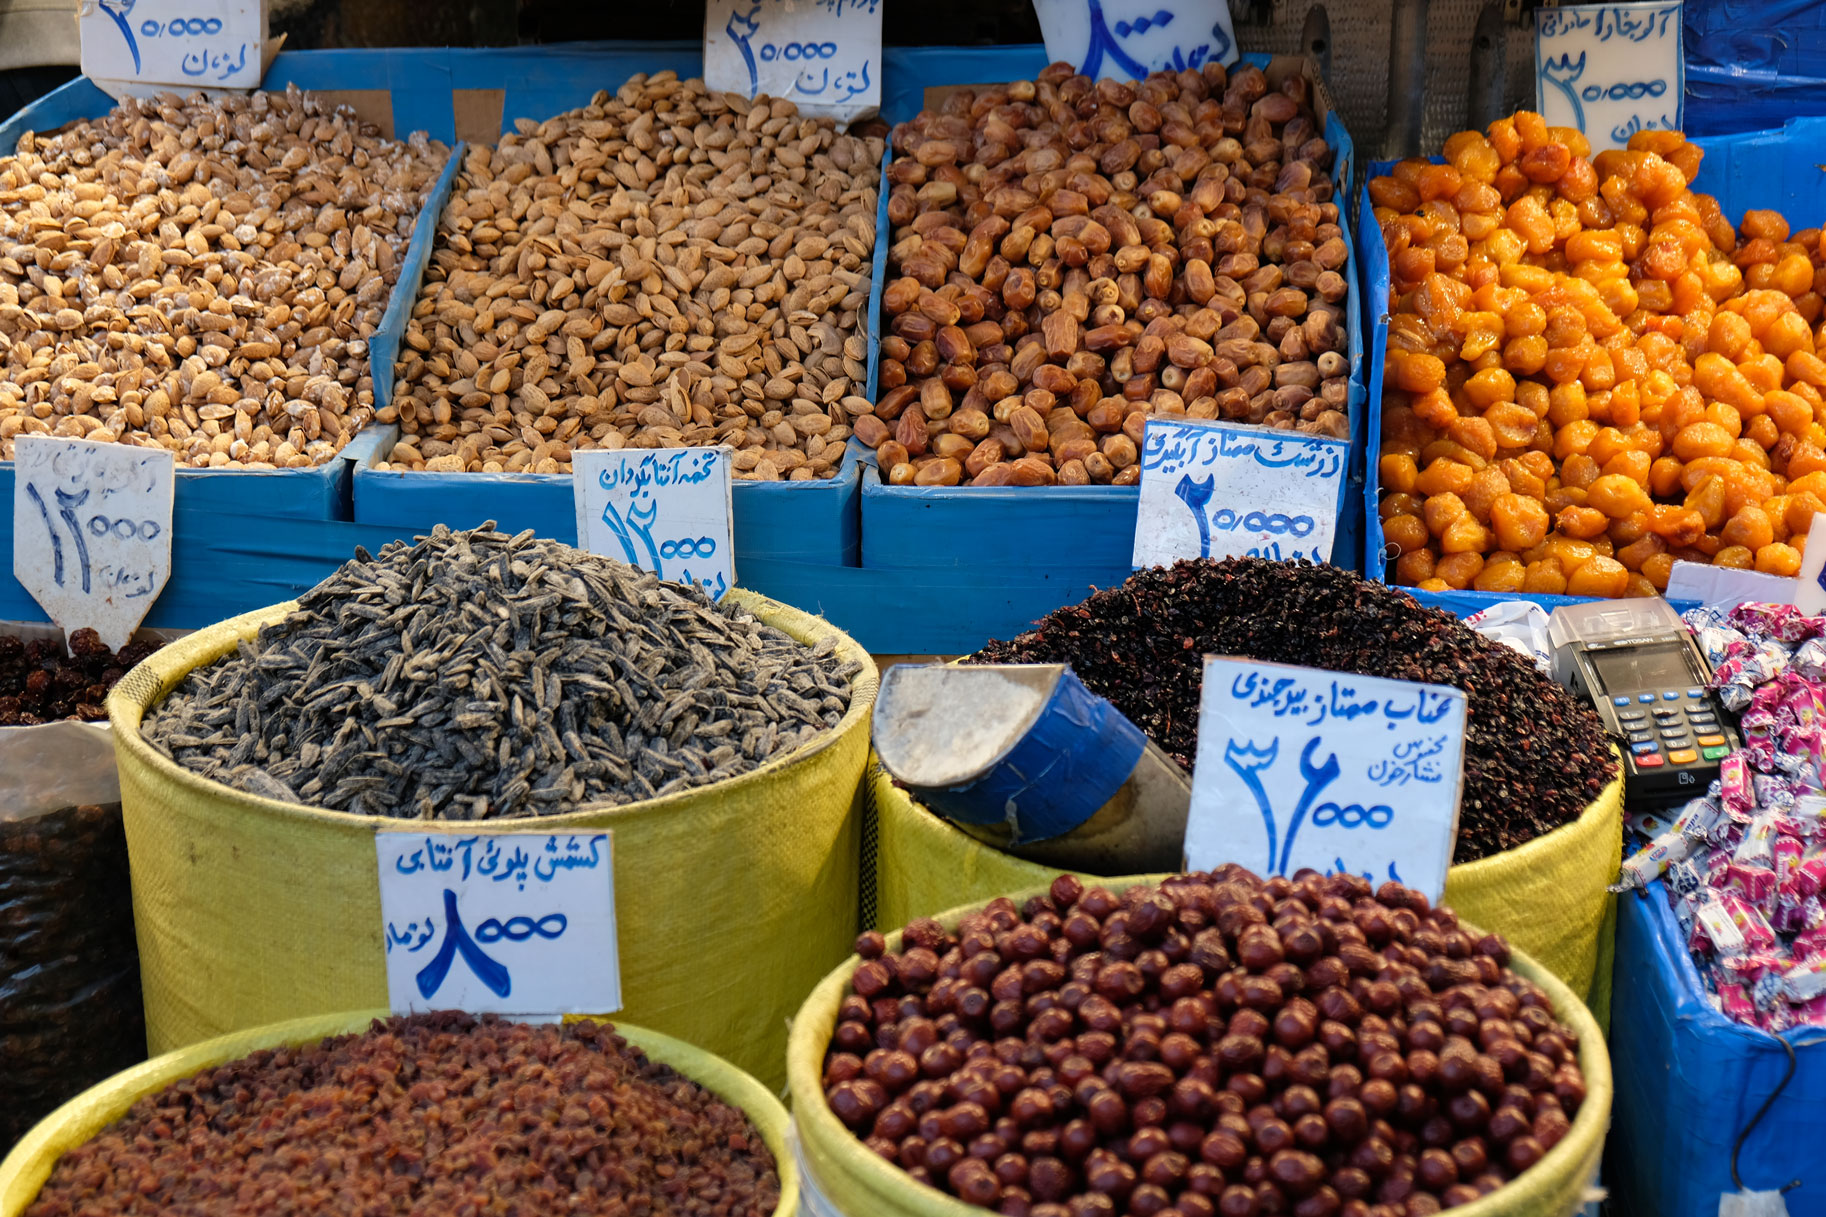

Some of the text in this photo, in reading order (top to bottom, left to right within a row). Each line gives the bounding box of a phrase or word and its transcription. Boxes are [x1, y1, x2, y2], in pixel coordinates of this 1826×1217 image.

[1306, 681, 1379, 726] ممتاز
[1384, 688, 1454, 730] عناب
[534, 834, 608, 882] کشمش
